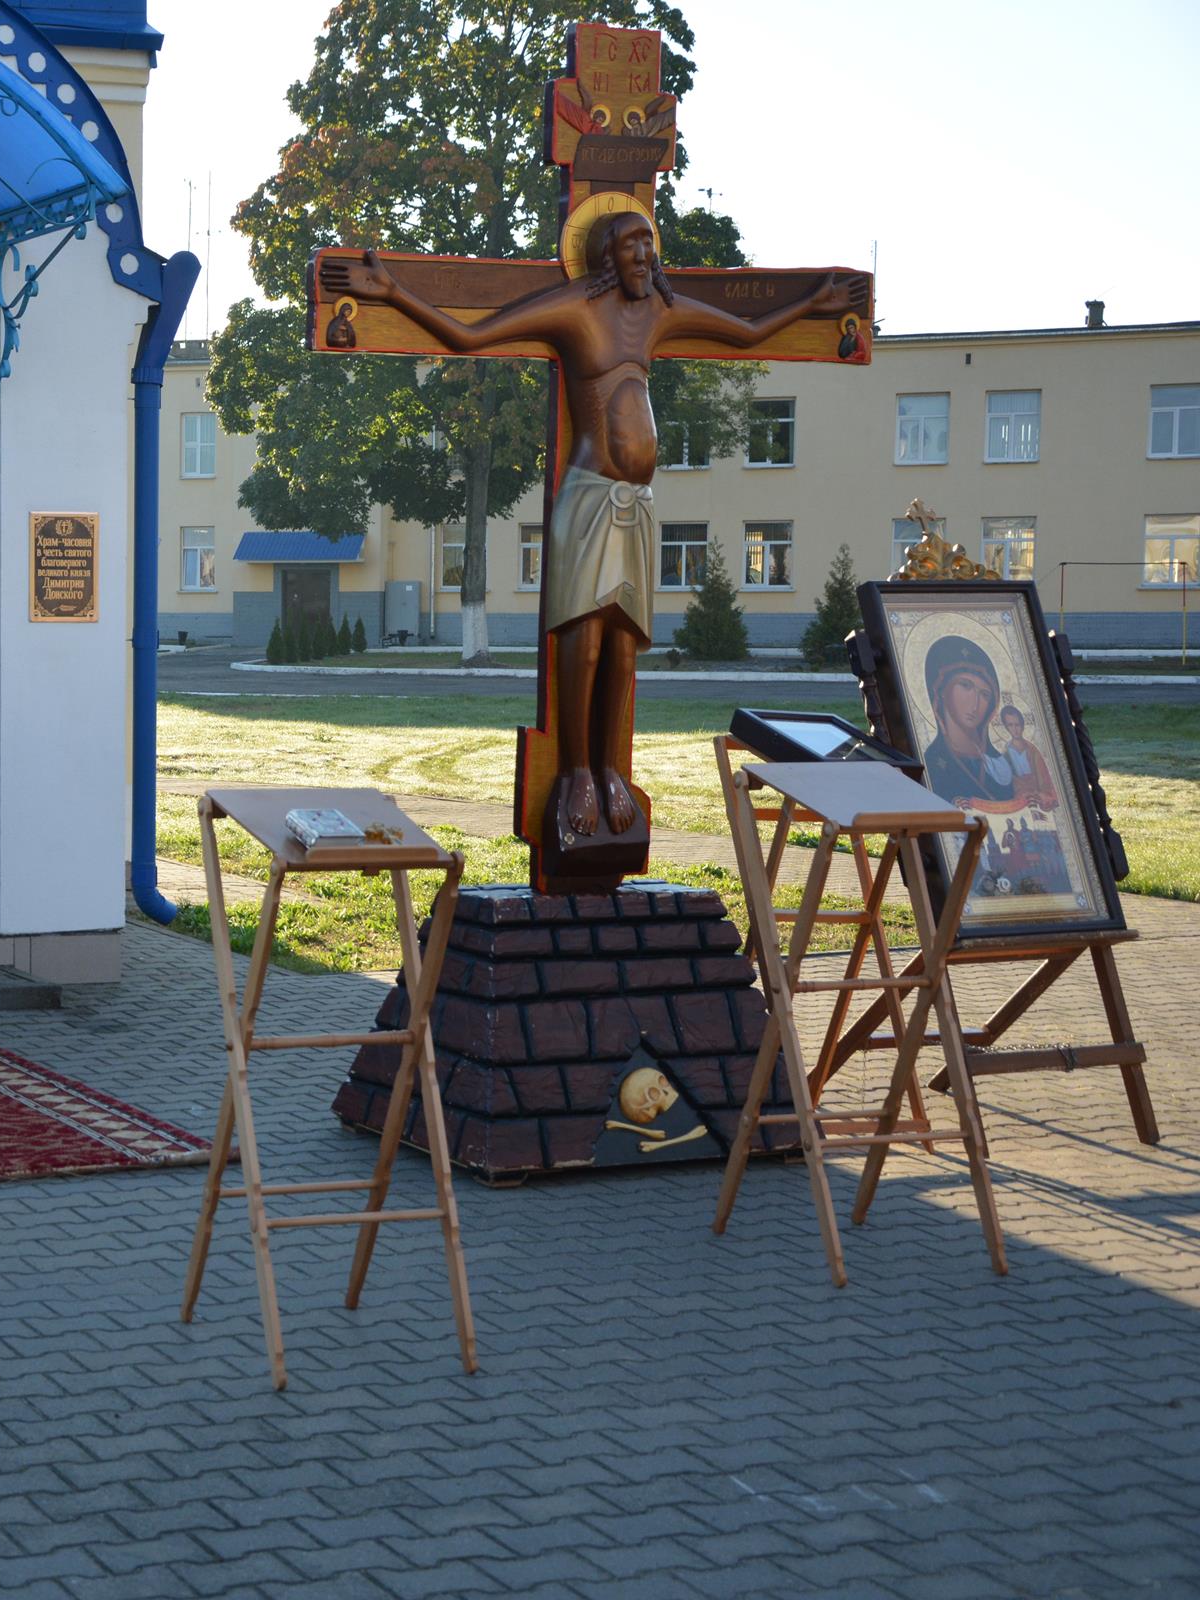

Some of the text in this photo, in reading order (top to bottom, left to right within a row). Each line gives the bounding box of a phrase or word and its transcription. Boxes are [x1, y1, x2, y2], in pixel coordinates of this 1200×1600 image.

[43, 548, 63, 557] честь
[64, 549, 92, 557] святого
[41, 557, 87, 569] благоверного
[37, 569, 91, 577] великого князя
[43, 588, 83, 599] Донского
